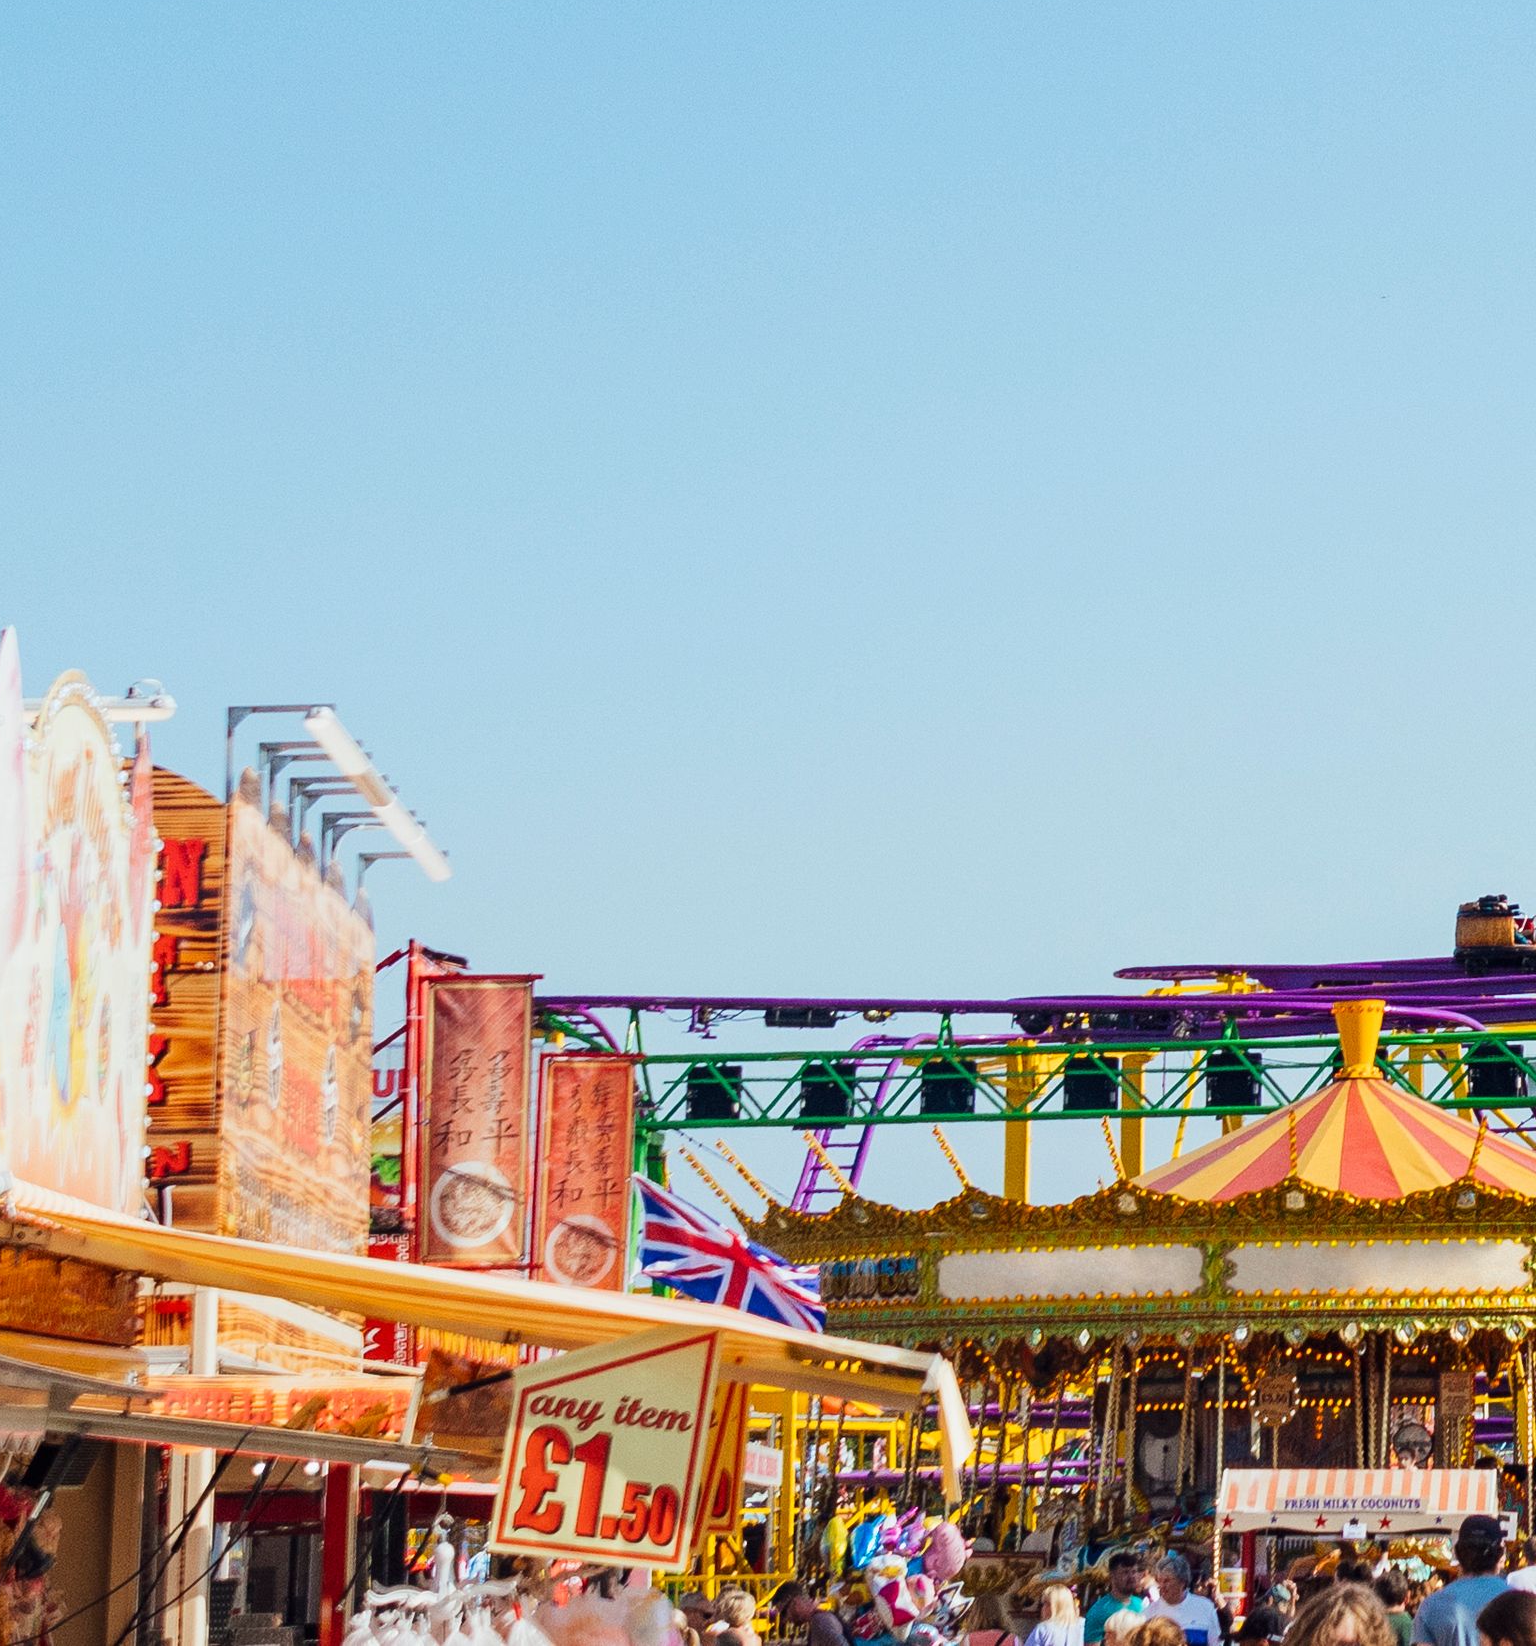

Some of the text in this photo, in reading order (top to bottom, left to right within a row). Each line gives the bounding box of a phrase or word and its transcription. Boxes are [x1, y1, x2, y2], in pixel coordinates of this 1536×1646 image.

[529, 1394, 693, 1432] any item
[513, 1423, 681, 1546] £1.50
[1284, 1497, 1421, 1510] FRESH MILKY COCONUTS
